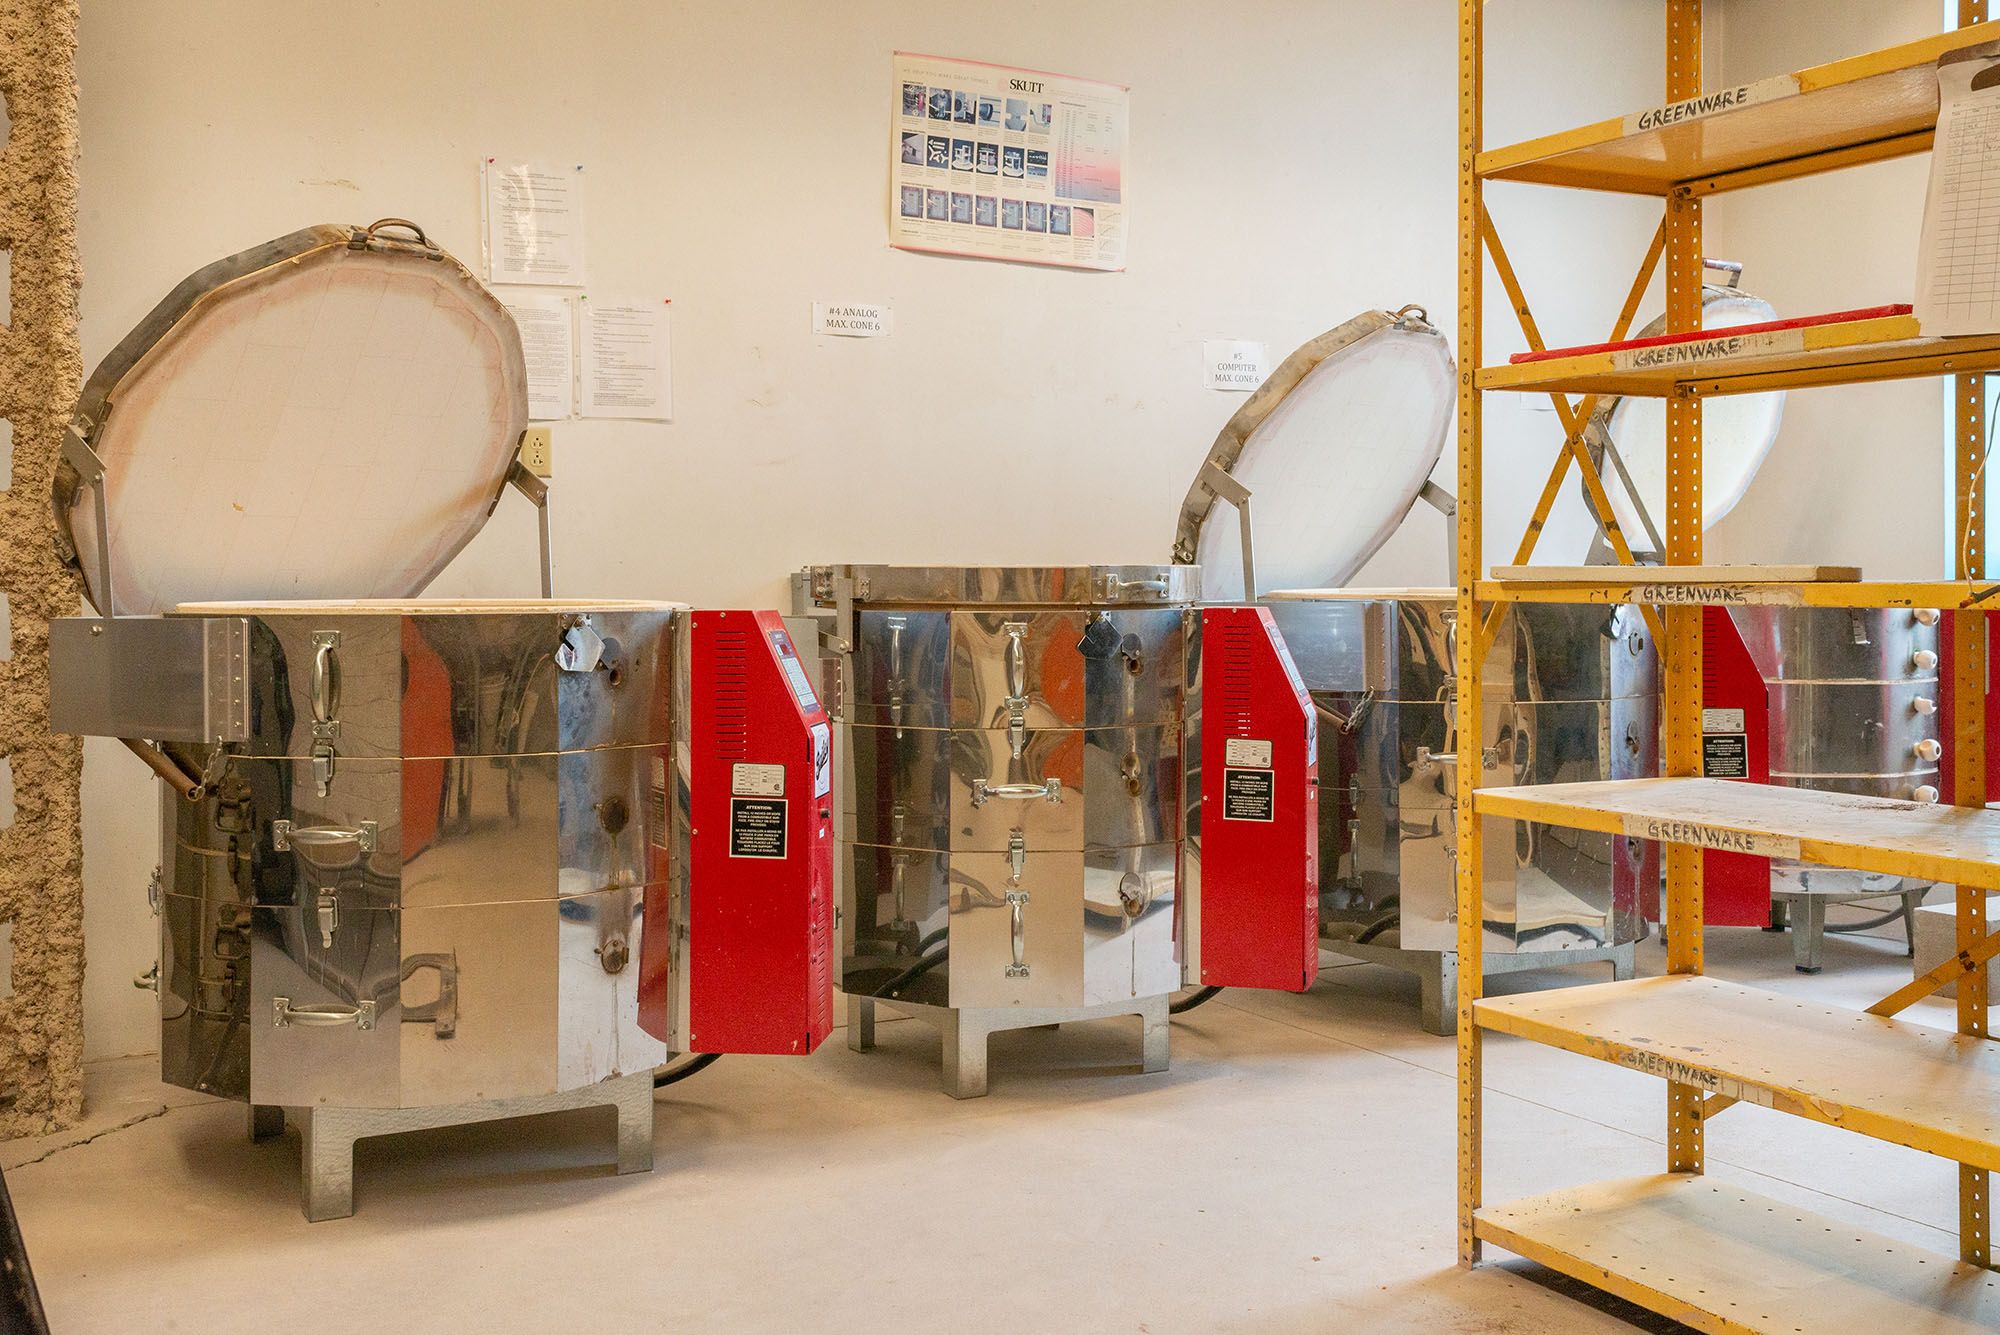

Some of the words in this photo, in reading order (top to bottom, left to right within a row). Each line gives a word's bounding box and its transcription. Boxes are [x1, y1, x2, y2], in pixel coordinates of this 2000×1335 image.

[1010, 78, 1044, 93] SKUTT
[1638, 87, 1748, 130] GREENWARE
[829, 307, 840, 315] #4
[843, 308, 878, 318] ANALOG
[827, 319, 848, 328] MAX.
[850, 321, 873, 330] CONE
[875, 322, 880, 330] 6
[1633, 337, 1741, 367] GREENWARE
[1217, 363, 1256, 372] COMPUTER
[1235, 375, 1253, 383] CONE
[1643, 585, 1745, 602] GREENWARE
[1648, 820, 1755, 850] GREENWARE
[1627, 1051, 1719, 1086] GREENWARE
